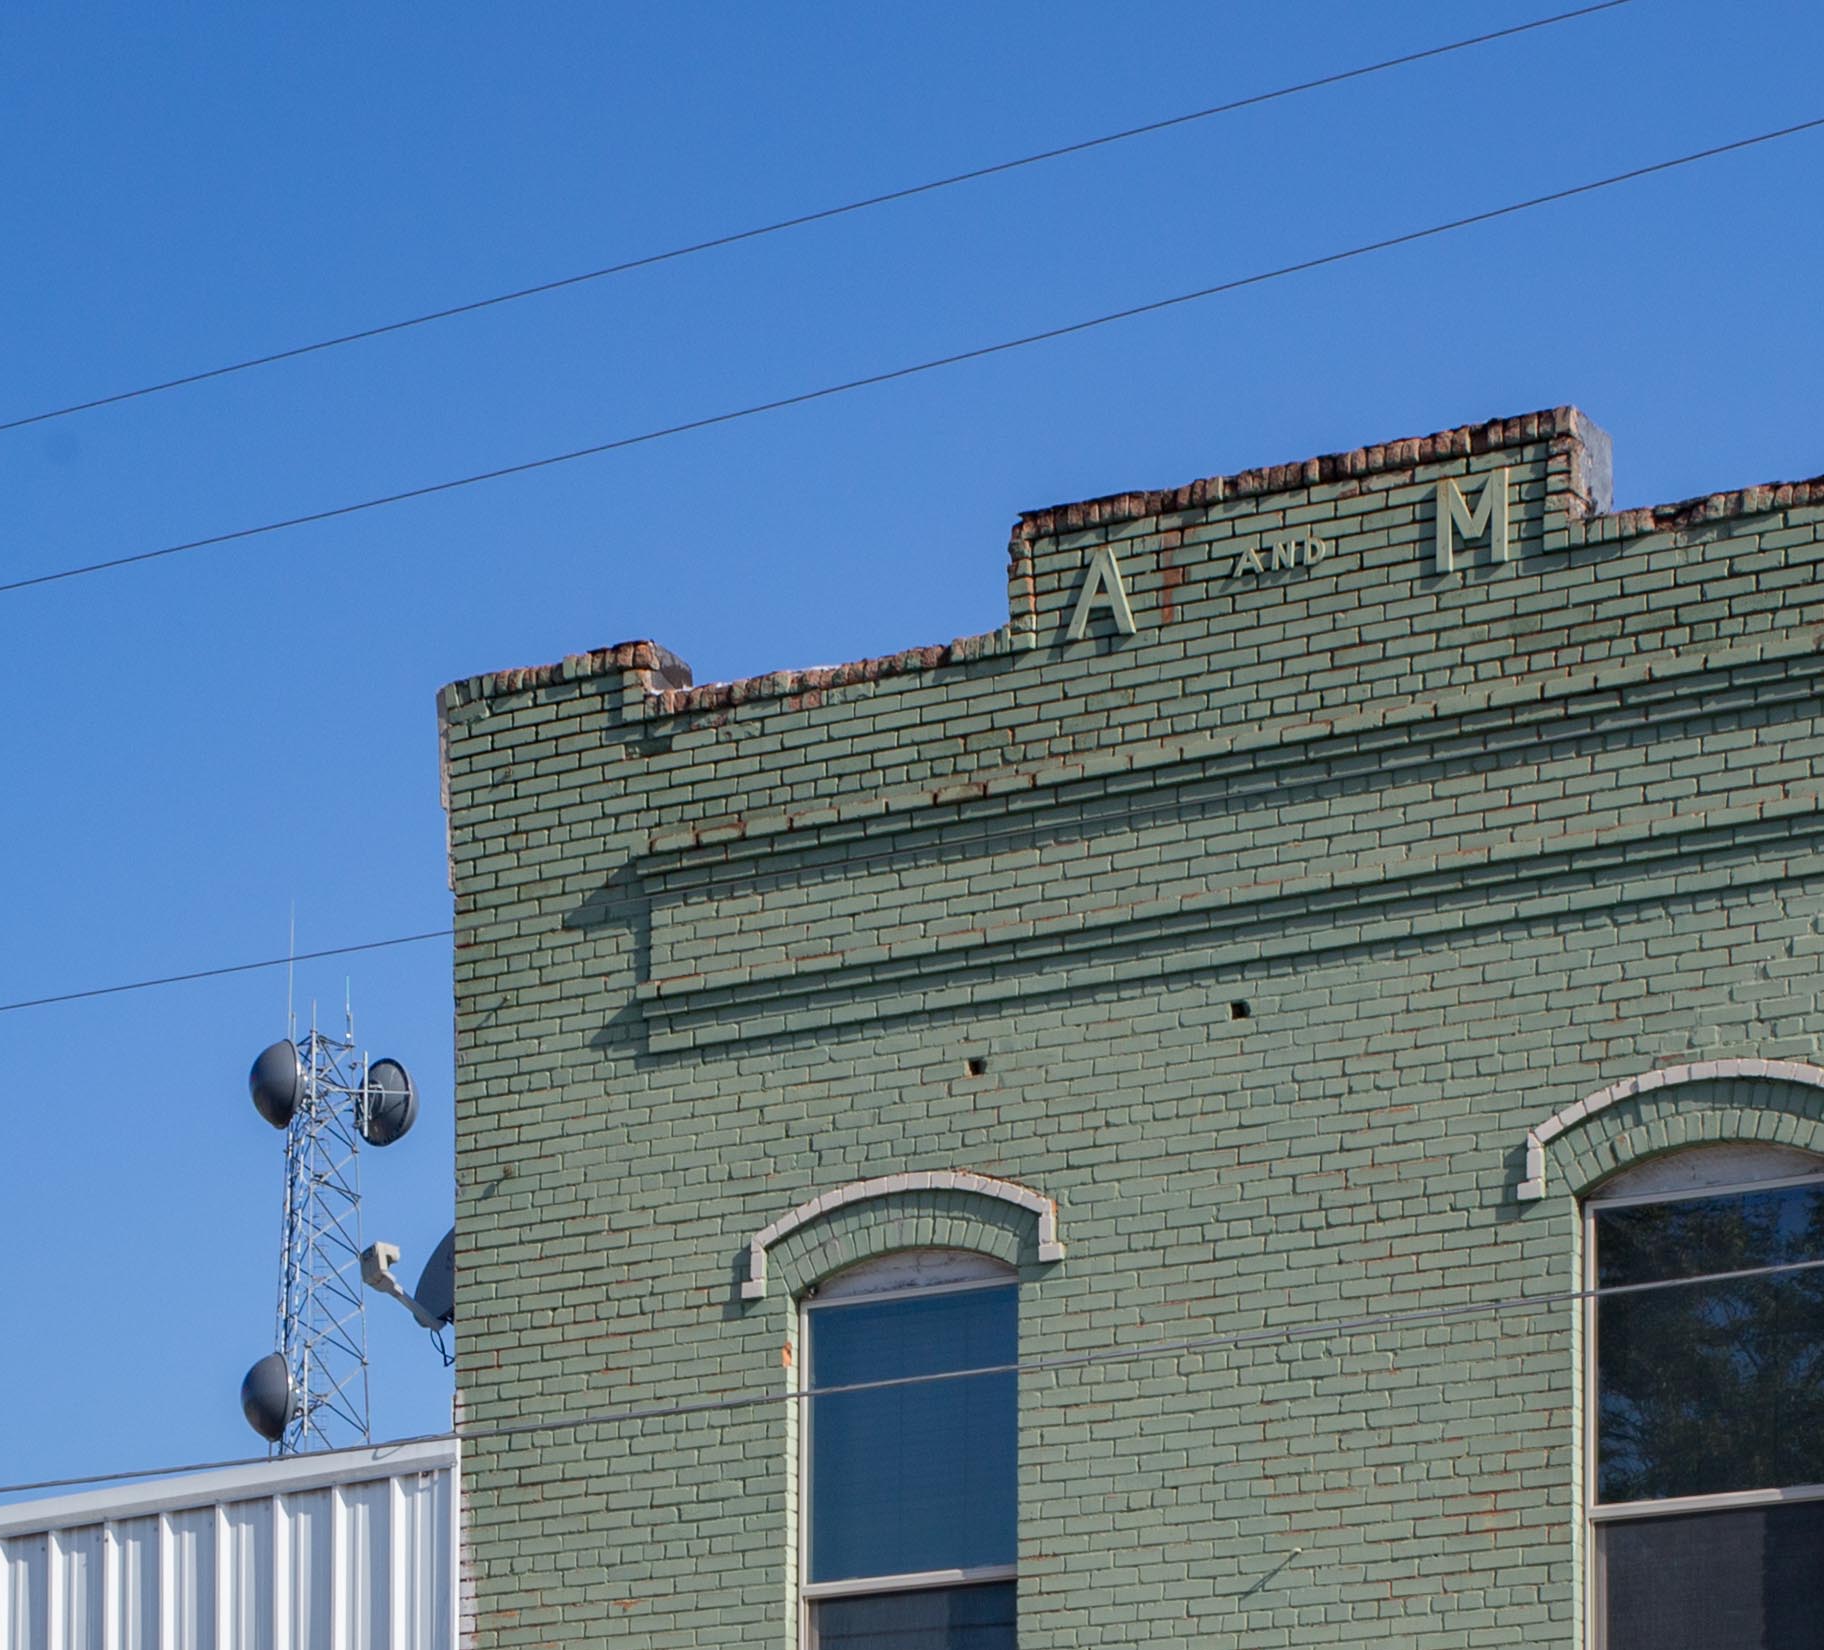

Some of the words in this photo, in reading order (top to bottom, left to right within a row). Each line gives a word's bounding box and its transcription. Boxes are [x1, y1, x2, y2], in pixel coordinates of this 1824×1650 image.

[1066, 546, 1136, 640] A
[1232, 536, 1326, 578] AND
[1435, 467, 1510, 573] M
